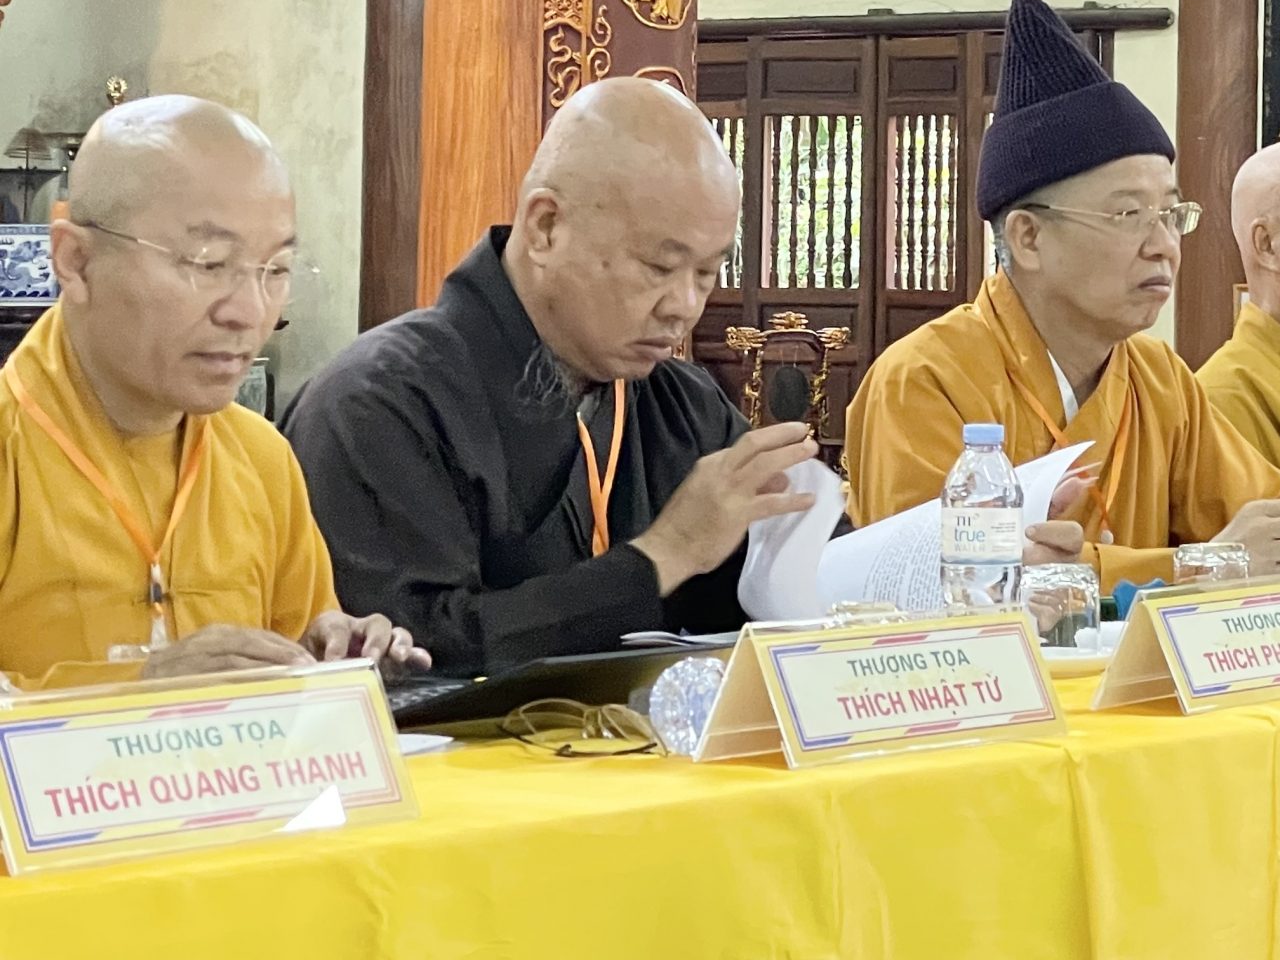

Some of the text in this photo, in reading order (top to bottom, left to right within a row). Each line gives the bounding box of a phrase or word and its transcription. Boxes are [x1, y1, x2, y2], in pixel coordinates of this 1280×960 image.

[954, 528, 985, 542] true
[847, 649, 970, 678] THƯỢNG TỌA
[1203, 644, 1260, 673] THÍCH
[837, 673, 1003, 720] THÍCH NHẬT TỪ
[107, 720, 286, 758] THƯỢNG TỌA
[44, 776, 142, 817] THÍCH
[150, 765, 261, 805] QUANG
